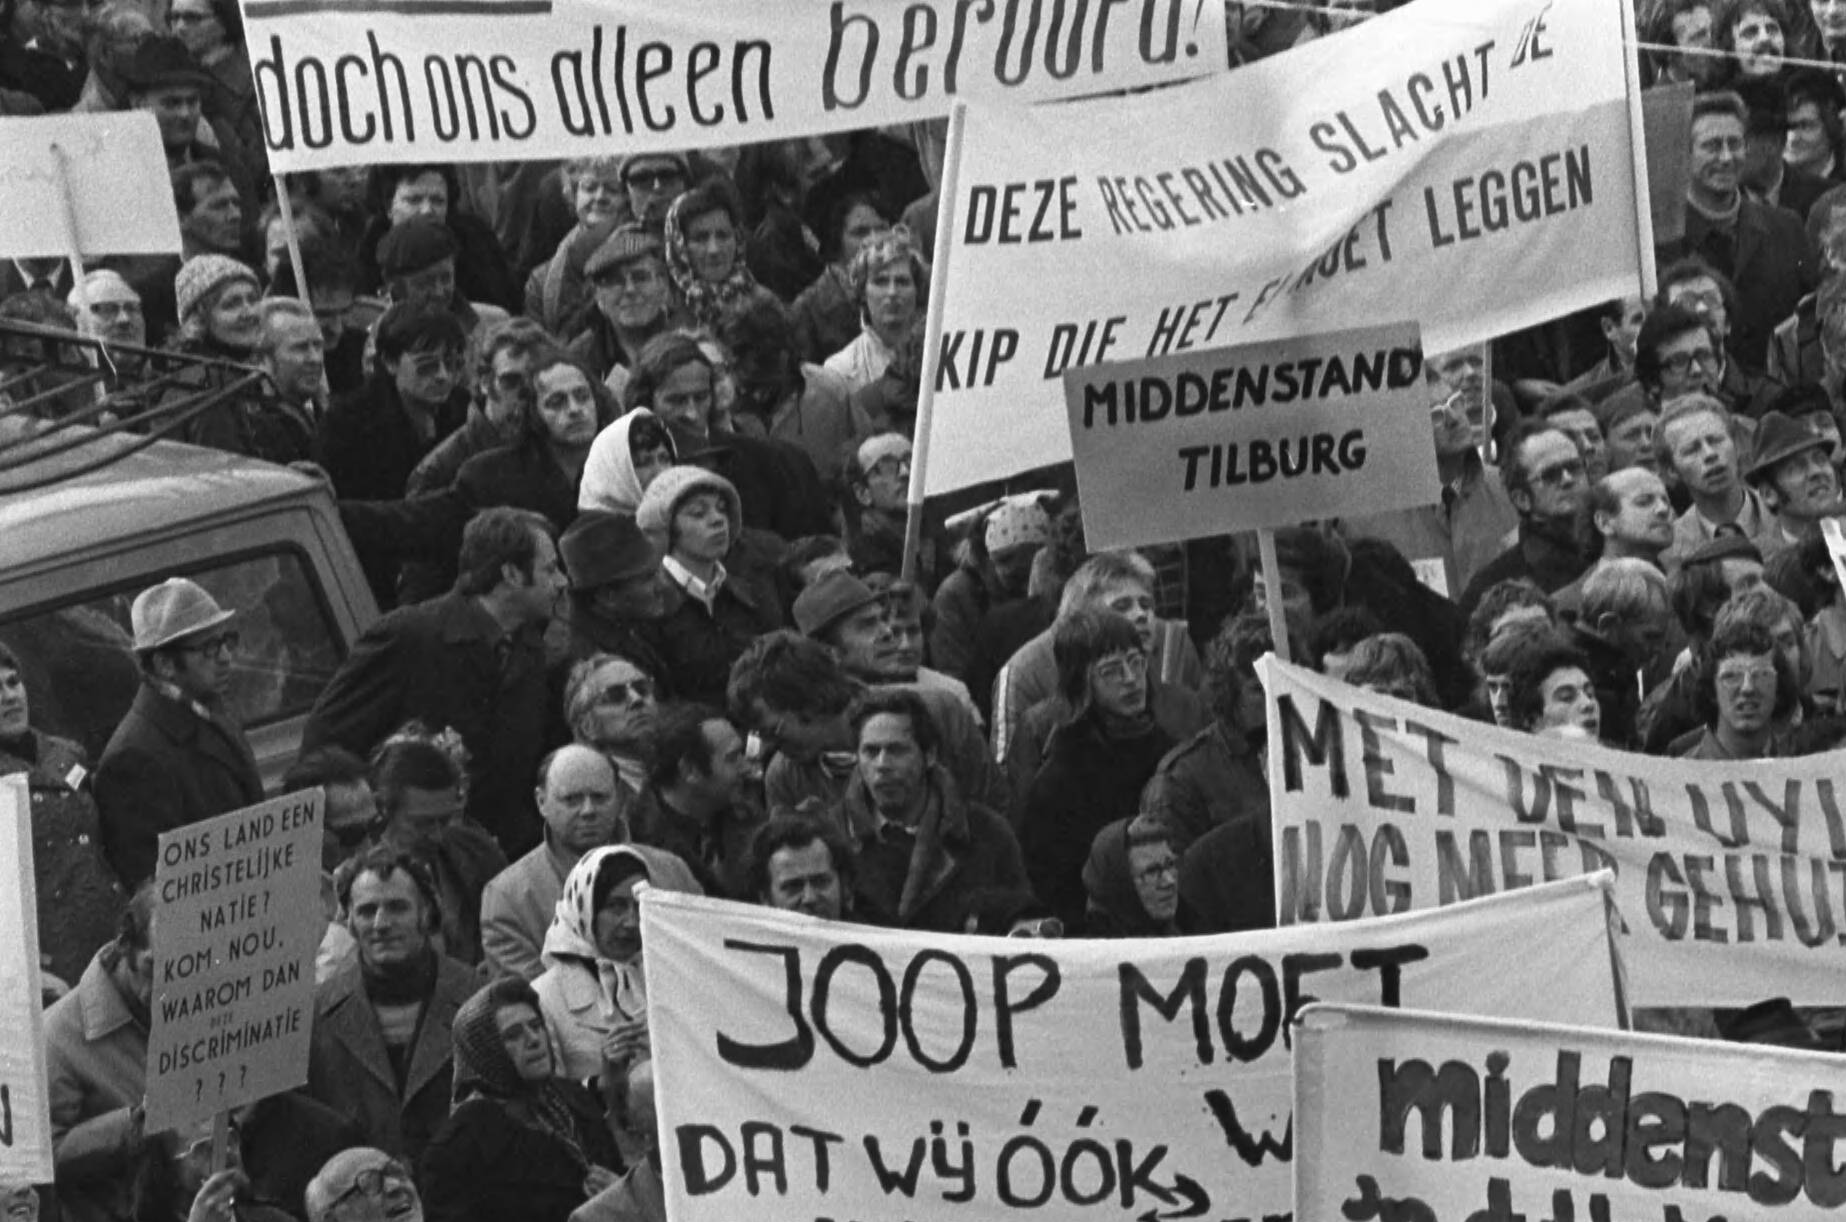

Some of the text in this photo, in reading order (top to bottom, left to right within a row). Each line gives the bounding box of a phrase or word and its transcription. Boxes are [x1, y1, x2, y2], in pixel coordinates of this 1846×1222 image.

[423, 53, 537, 143] ons
[551, 24, 774, 137] alleen
[964, 175, 1082, 245] DEZE
[1097, 147, 1307, 235] REGERING
[1309, 40, 1495, 174] SLACHT
[935, 327, 1020, 392] KIP
[1044, 315, 1127, 380] DIE
[1145, 292, 1239, 357] HET
[1424, 143, 1593, 249] LEGGEN
[1081, 347, 1424, 428] MIDDENSTAND
[1178, 430, 1367, 492] TILBURG
[1277, 693, 1460, 817] MET
[1493, 753, 1666, 840] DEN
[164, 801, 315, 867] ONS LAND EEN
[1279, 819, 1412, 926] NOG
[162, 959, 300, 1024] WAAROM DAN
[164, 926, 284, 983] KOM NOU.
[716, 937, 1063, 1073] JOOP
[675, 1121, 843, 1198] DAT
